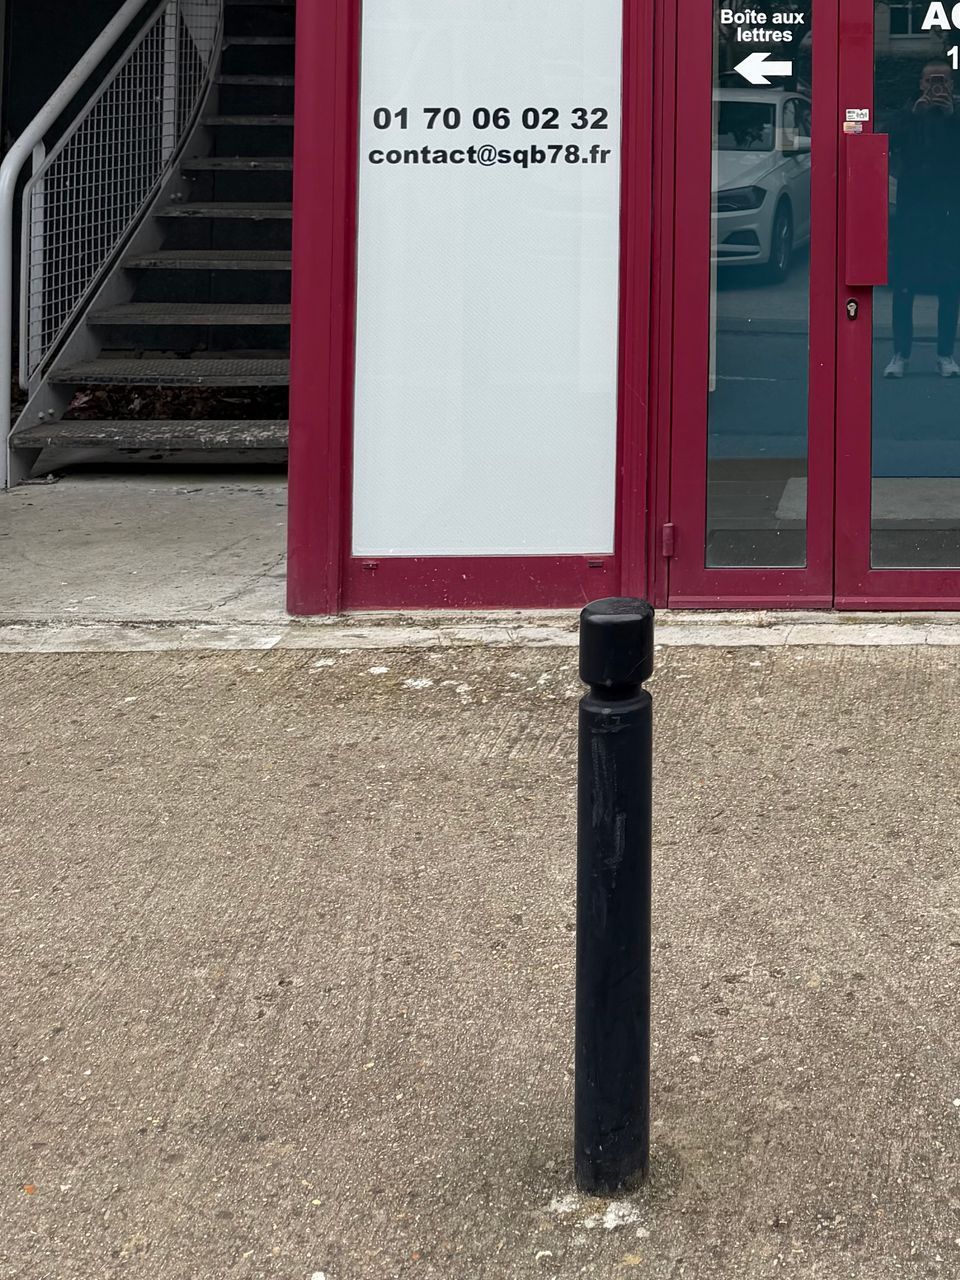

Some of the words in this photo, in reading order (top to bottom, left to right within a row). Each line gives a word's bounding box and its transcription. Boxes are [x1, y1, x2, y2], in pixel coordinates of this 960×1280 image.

[721, 9, 766, 24] Boîte
[772, 13, 804, 24] aux
[737, 27, 792, 41] lettres
[374, 108, 407, 129] 01
[424, 108, 460, 129] 70
[473, 108, 510, 129] 06
[522, 108, 559, 129] 02
[571, 108, 607, 129] 32
[369, 145, 611, 168] contact@sqb78.fr
